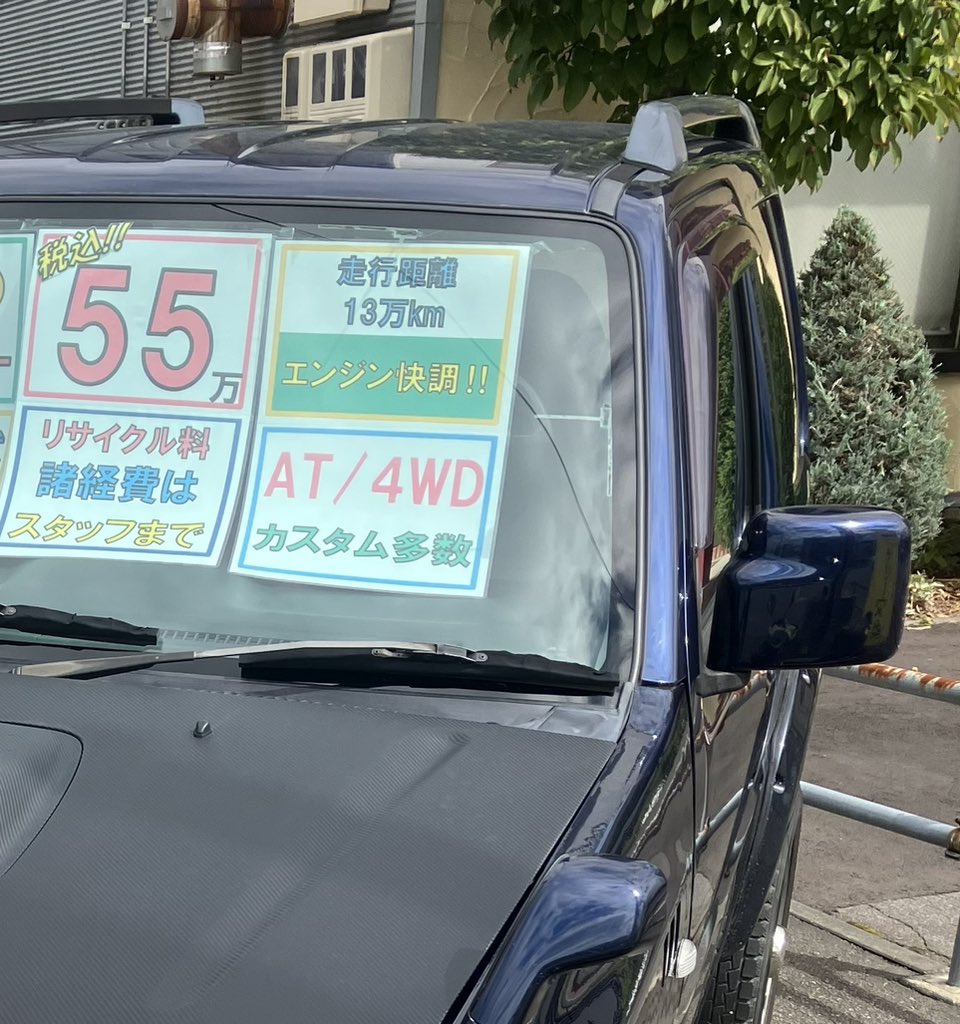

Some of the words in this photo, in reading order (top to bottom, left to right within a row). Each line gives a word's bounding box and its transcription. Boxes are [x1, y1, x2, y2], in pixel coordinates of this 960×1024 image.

[337, 256, 459, 289] 走行距離
[343, 297, 446, 329] 13万km
[42, 419, 212, 461] リサイクル料
[35, 461, 199, 505] 諸経費は
[263, 451, 485, 509] AT/4WD
[7, 512, 206, 549] スタッフまで
[252, 523, 474, 568] カスタム多数
